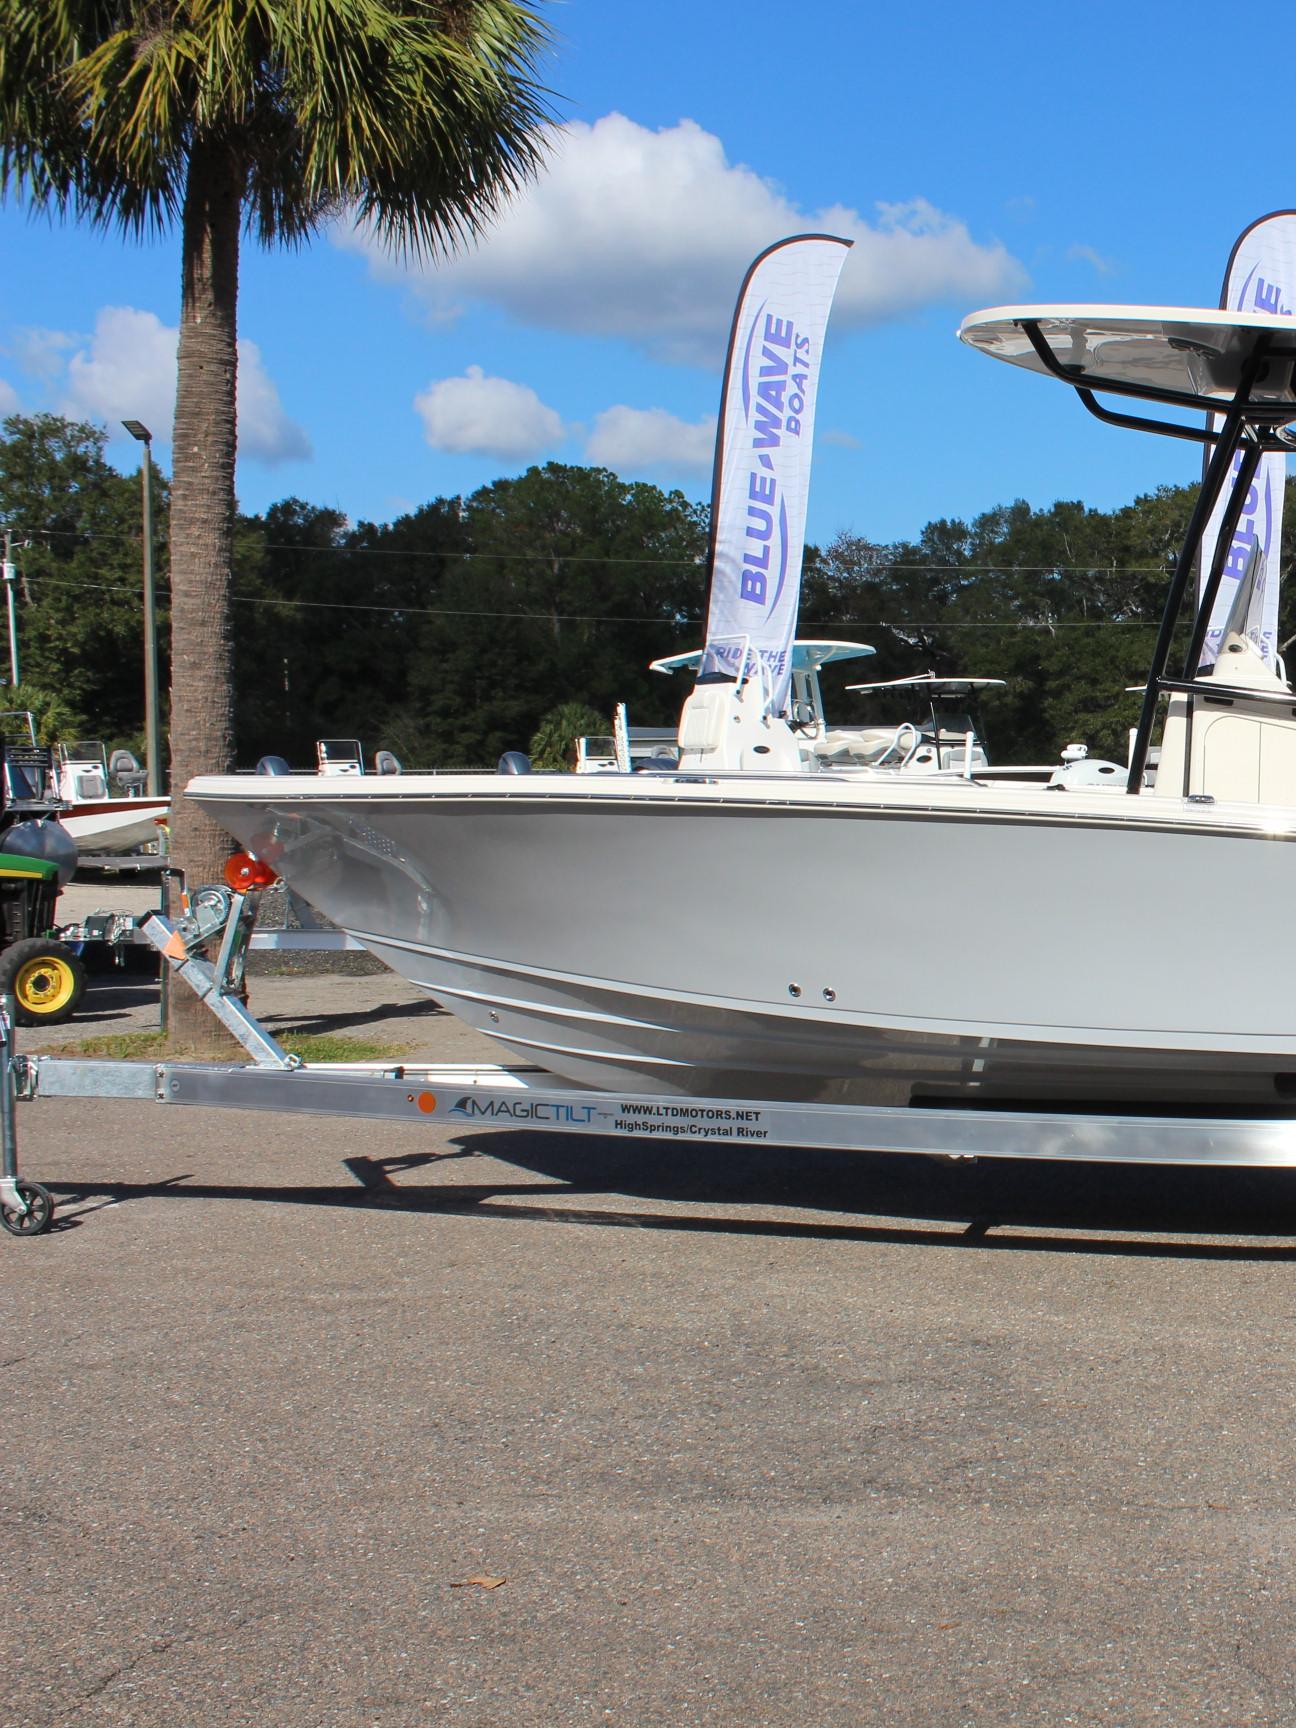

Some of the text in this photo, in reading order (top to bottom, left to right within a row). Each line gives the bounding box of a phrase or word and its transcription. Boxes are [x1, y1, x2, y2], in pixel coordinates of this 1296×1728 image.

[786, 333, 810, 437] BOATS
[741, 313, 794, 606] BLUE WAVE
[758, 649, 786, 663] THE
[472, 1099, 597, 1123] MAGICTILT
[620, 1103, 761, 1122] WWW.LTDMOTORS.NET
[615, 1119, 769, 1138] HighSprings/Crystal River
